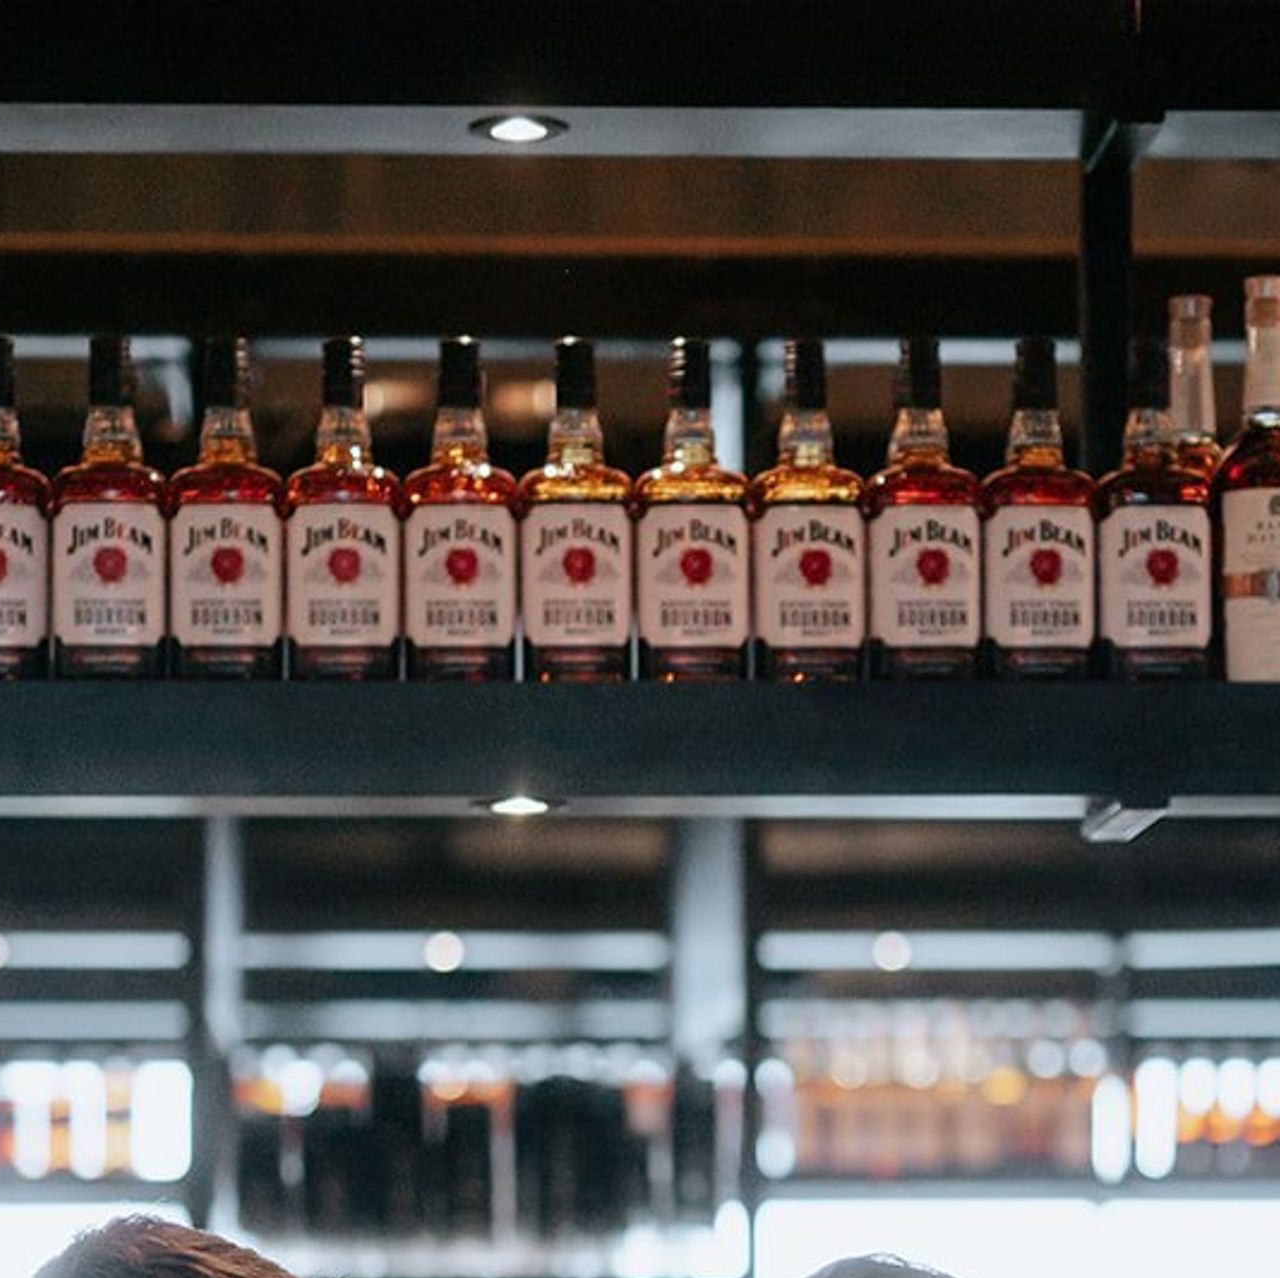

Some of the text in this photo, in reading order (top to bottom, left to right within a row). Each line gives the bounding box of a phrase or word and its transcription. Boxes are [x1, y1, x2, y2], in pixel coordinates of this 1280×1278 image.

[67, 517, 152, 555] JIM BEAM
[184, 518, 268, 555] JIM BEAM
[301, 518, 386, 556] JIM BEAM
[418, 518, 503, 557] JIM BEAM
[535, 518, 620, 555] JIM BEAM
[653, 519, 737, 557] JIM BEAM
[772, 520, 856, 557] JIM BEAM
[889, 519, 973, 558] JIM BEAM
[1002, 519, 1086, 558] JIM BEAM
[1118, 519, 1202, 558] JIM BEAM
